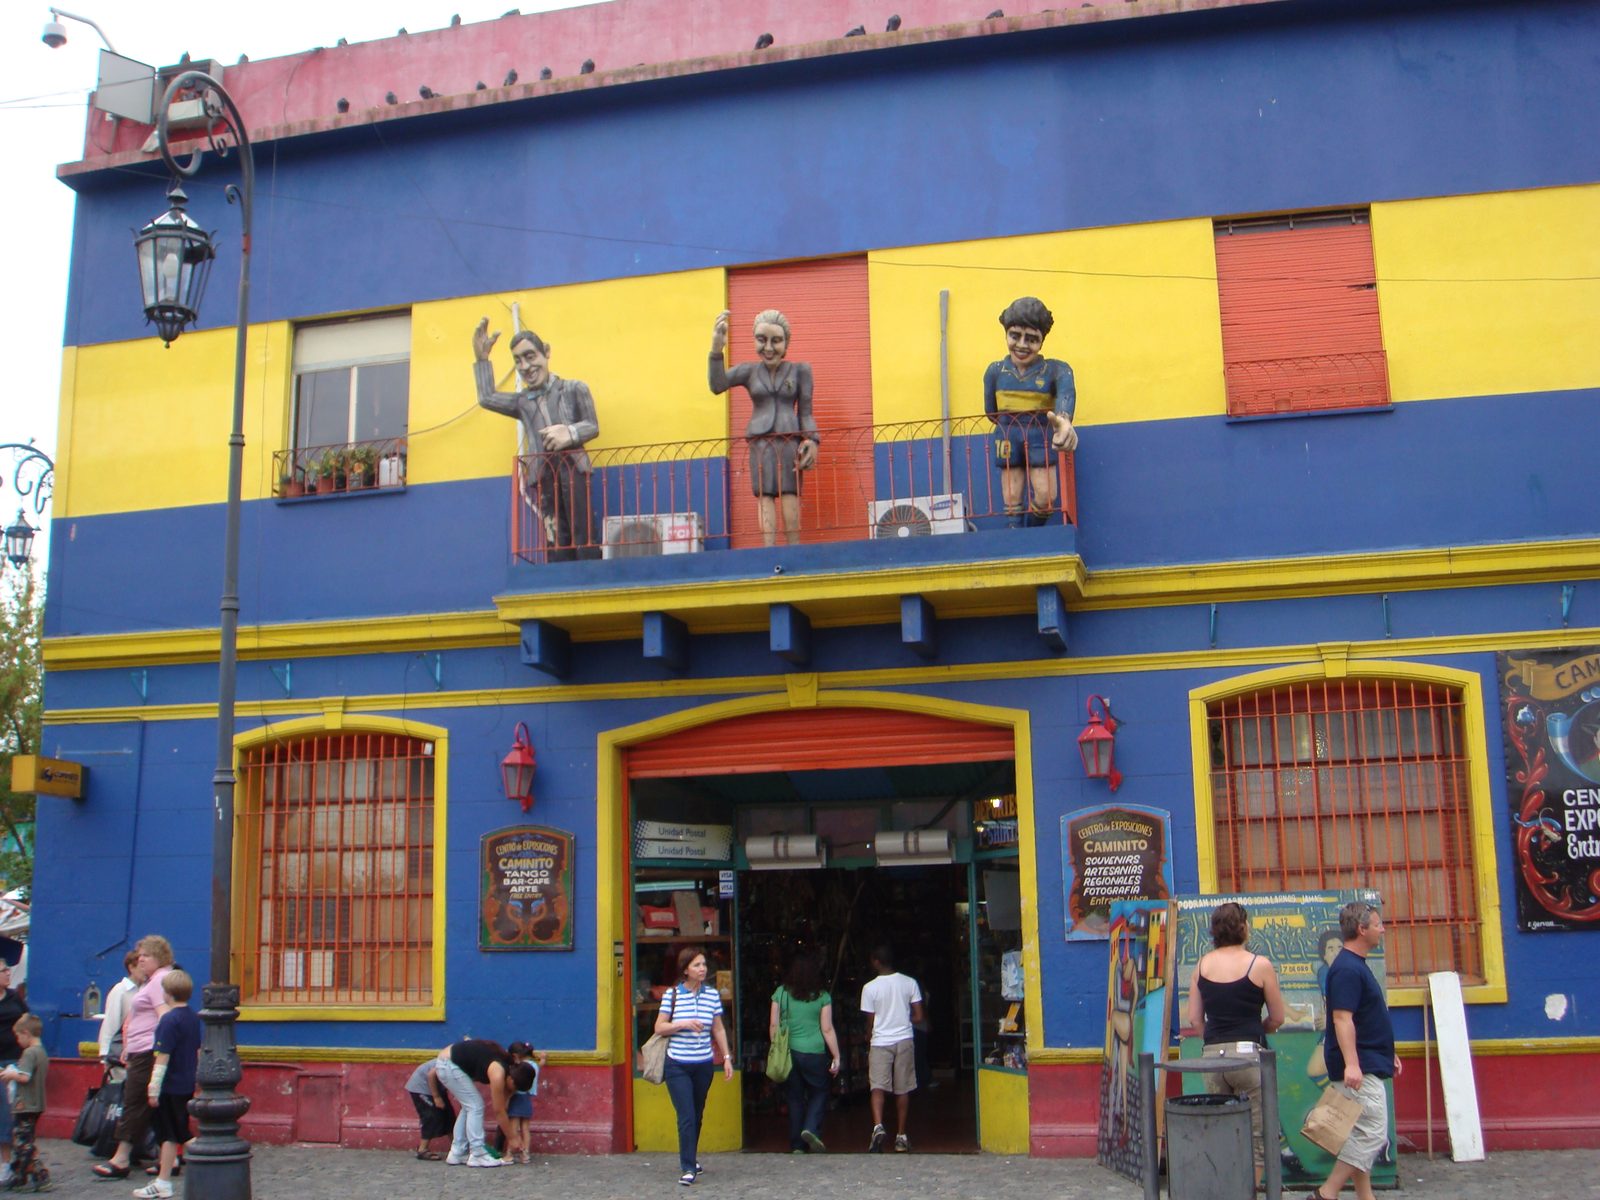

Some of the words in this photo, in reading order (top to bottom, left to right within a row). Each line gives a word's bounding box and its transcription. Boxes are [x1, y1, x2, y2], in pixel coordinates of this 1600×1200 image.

[995, 440, 1011, 459] 10
[658, 827, 683, 836] Unidad
[685, 828, 706, 837] Postal
[1078, 823, 1104, 840] CENTRO
[1112, 820, 1153, 837] EXPOSICIONES
[658, 846, 683, 855] Unidad
[685, 847, 706, 856] Postal
[1083, 840, 1148, 853] CAMINITO
[498, 857, 554, 870] CAMINITO
[1085, 855, 1140, 865] SOUVENIRS
[504, 870, 549, 878] TANGO
[1083, 875, 1141, 886] REGIONALES
[509, 885, 539, 893] ARTE
